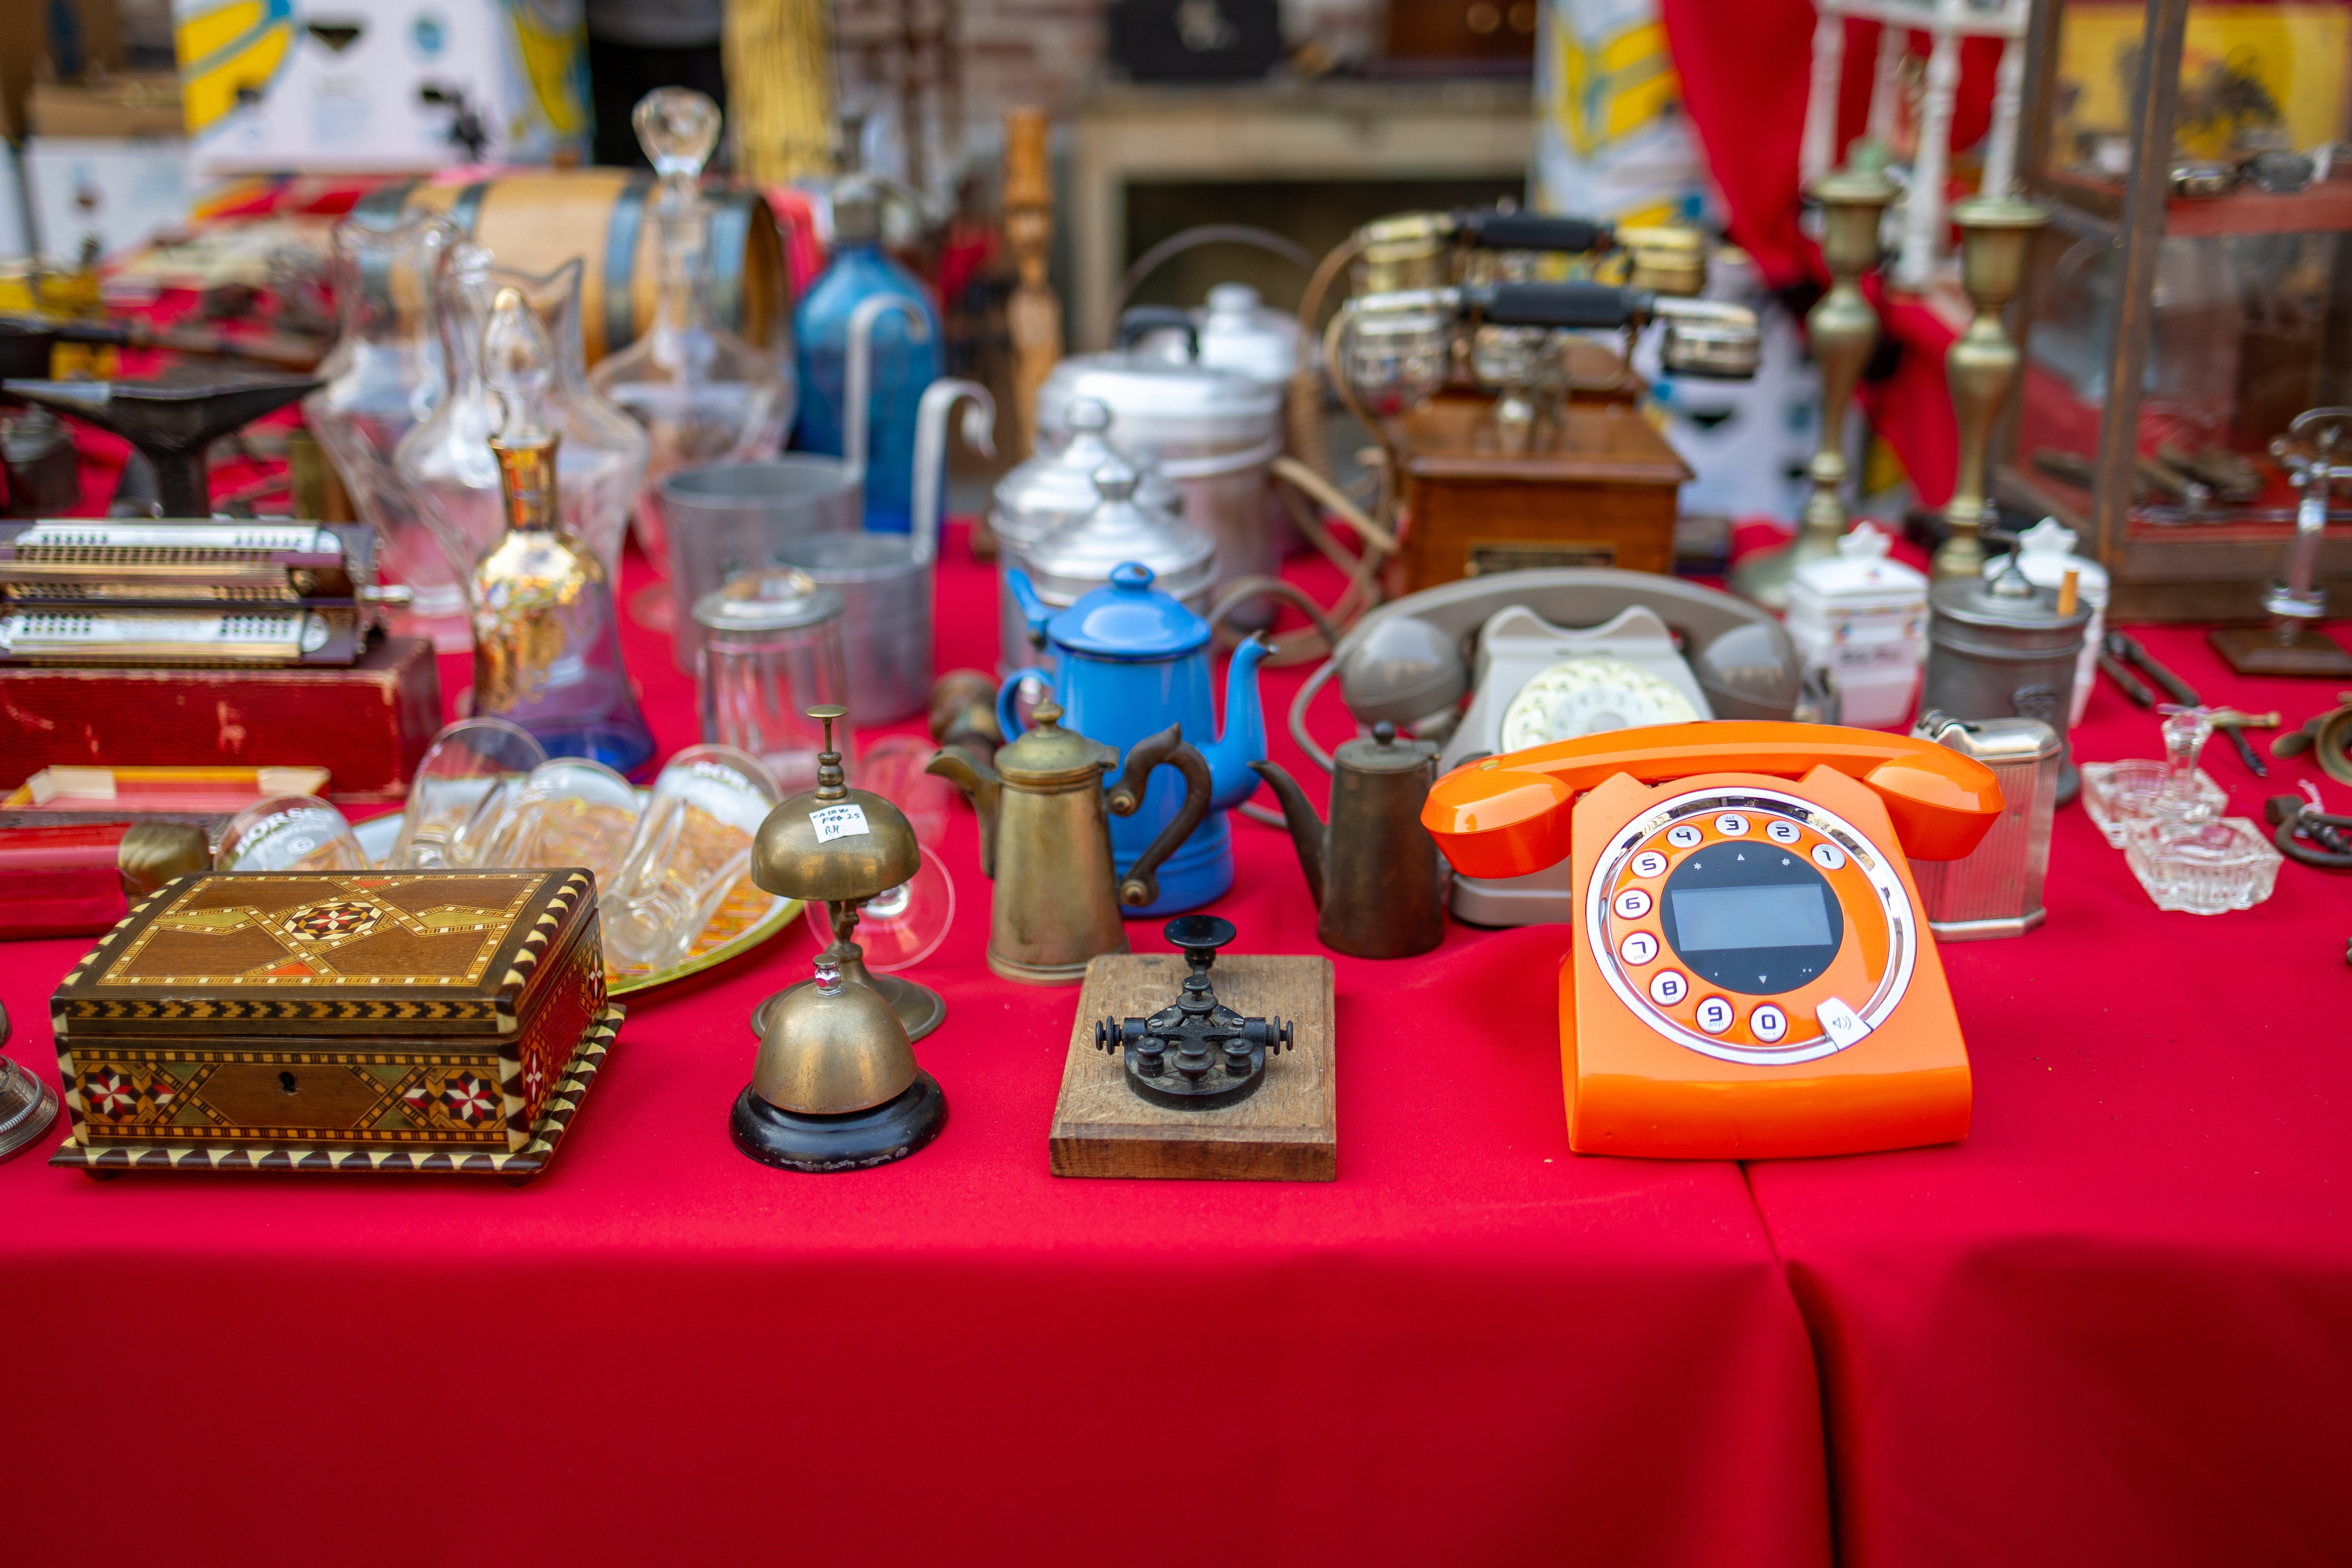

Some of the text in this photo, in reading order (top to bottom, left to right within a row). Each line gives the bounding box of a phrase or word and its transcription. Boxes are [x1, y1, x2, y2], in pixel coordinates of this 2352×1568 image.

[1725, 820, 1739, 830] 3
[1676, 831, 1692, 841] 4
[1775, 827, 1791, 837] 2
[1822, 850, 1831, 862] 1
[1642, 858, 1656, 871] 5
[1625, 897, 1640, 910] 6
[1631, 941, 1646, 954] 7
[1662, 981, 1677, 996] 8
[1707, 1006, 1722, 1022] 9
[1761, 1014, 1776, 1030] 0
